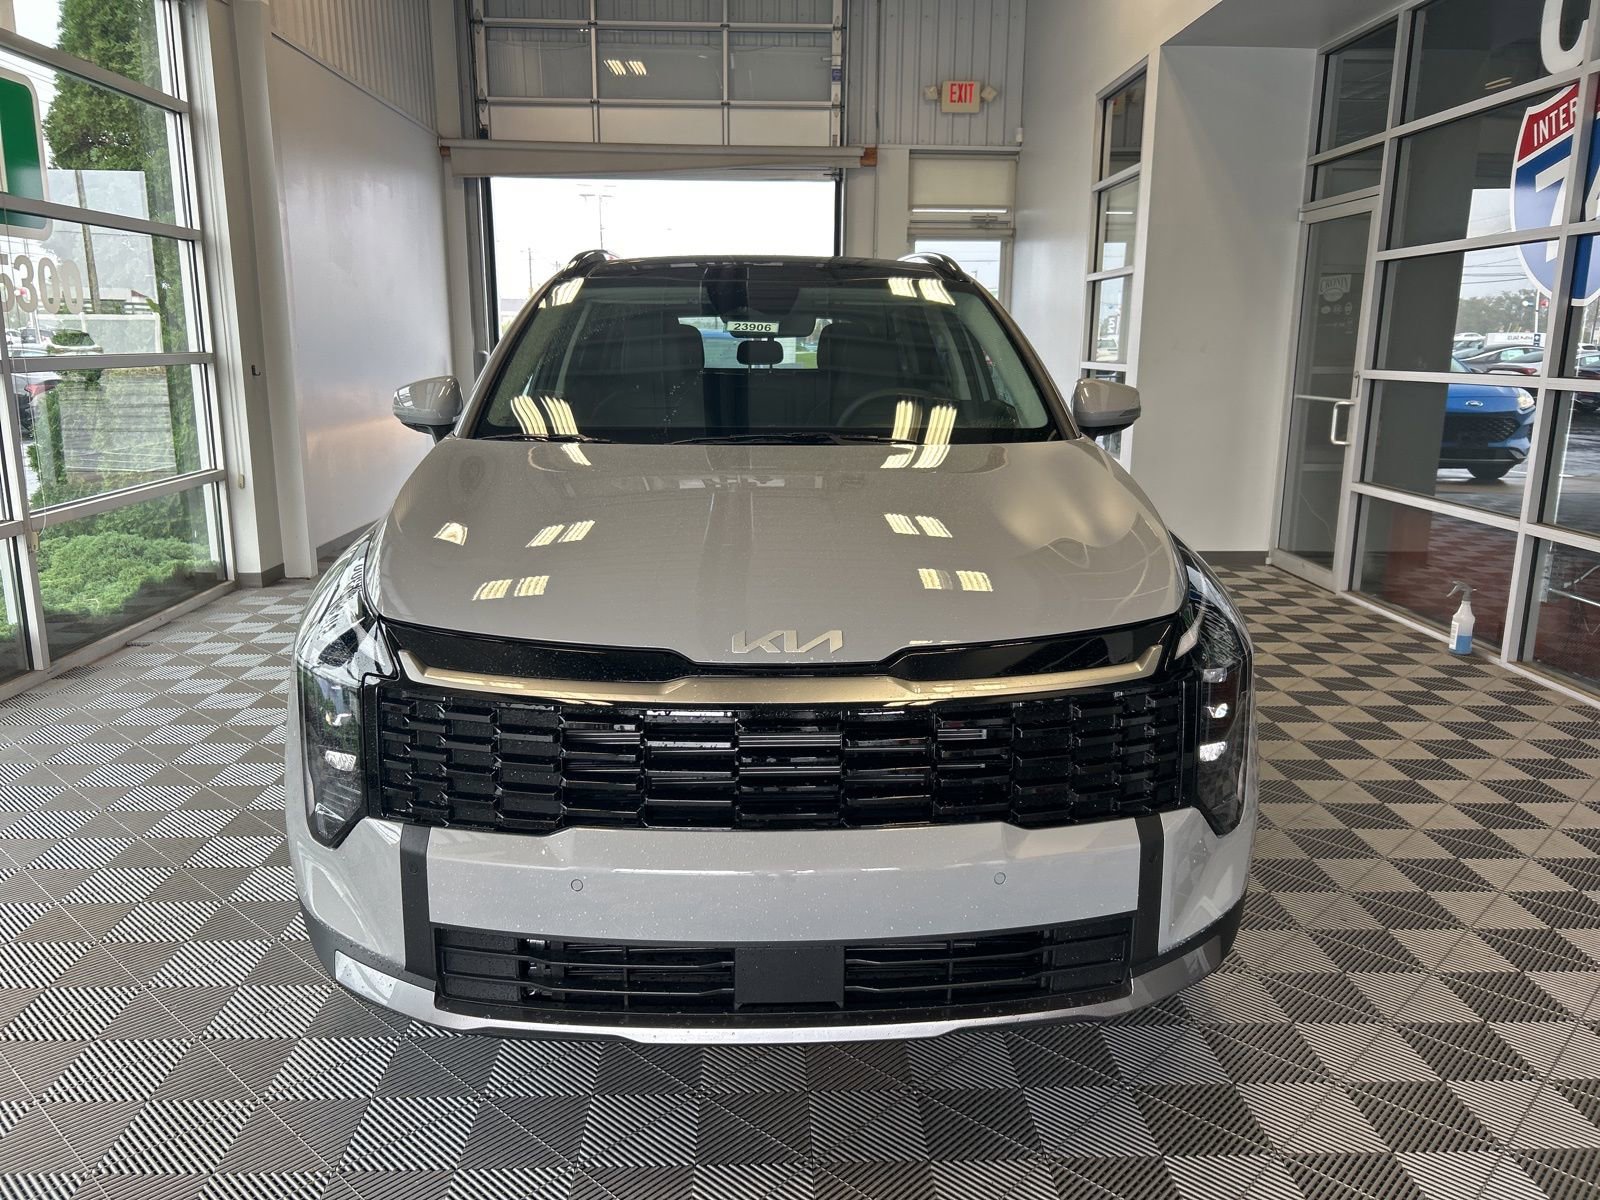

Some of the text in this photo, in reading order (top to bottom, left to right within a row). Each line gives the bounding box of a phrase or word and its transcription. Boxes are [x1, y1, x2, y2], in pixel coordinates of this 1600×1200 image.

[949, 83, 975, 104] EXIT
[0, 253, 83, 314] 5300
[733, 323, 772, 332] 23906
[732, 630, 843, 654] KIA
